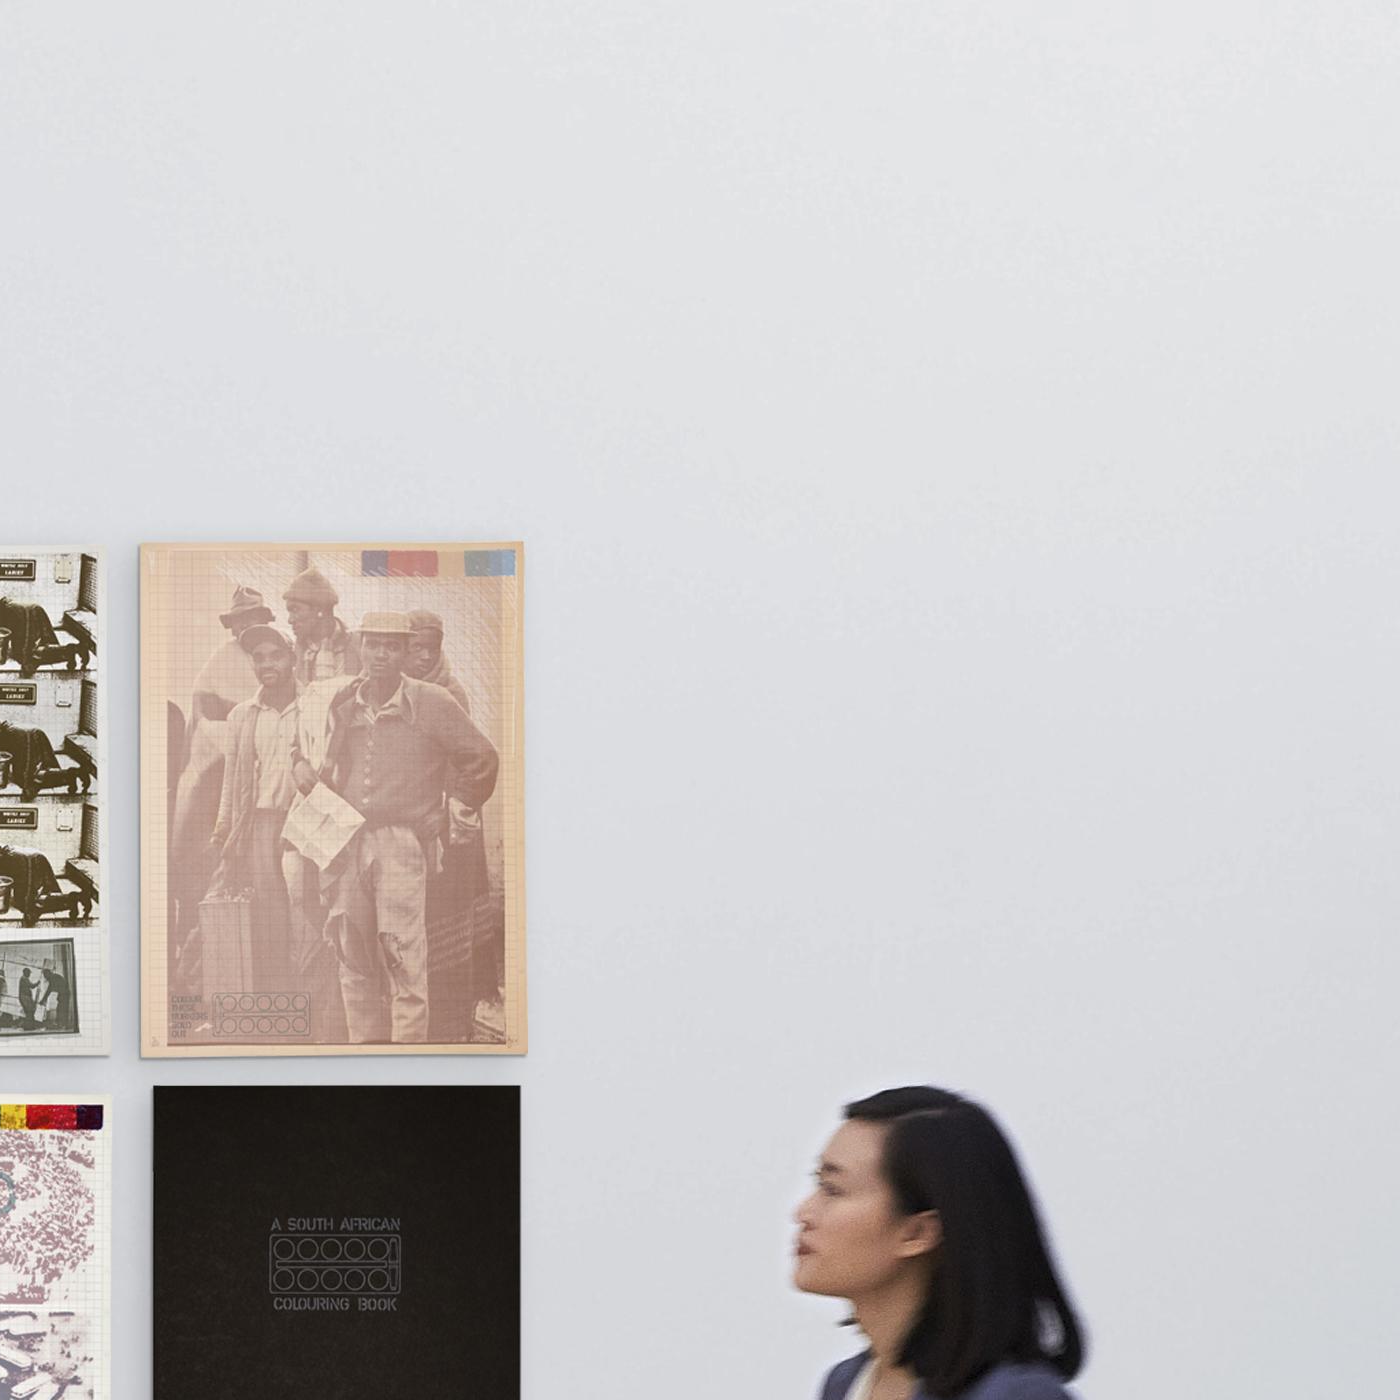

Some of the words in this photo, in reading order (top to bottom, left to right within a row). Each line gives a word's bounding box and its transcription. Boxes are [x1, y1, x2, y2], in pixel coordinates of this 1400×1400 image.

[171, 1030, 186, 1038] OUT
[271, 1218, 282, 1231] A
[287, 1218, 333, 1231] SOUTH
[340, 1218, 400, 1231] AFRICAN
[273, 1297, 350, 1311] COLOURING
[358, 1297, 398, 1311] BOOK
